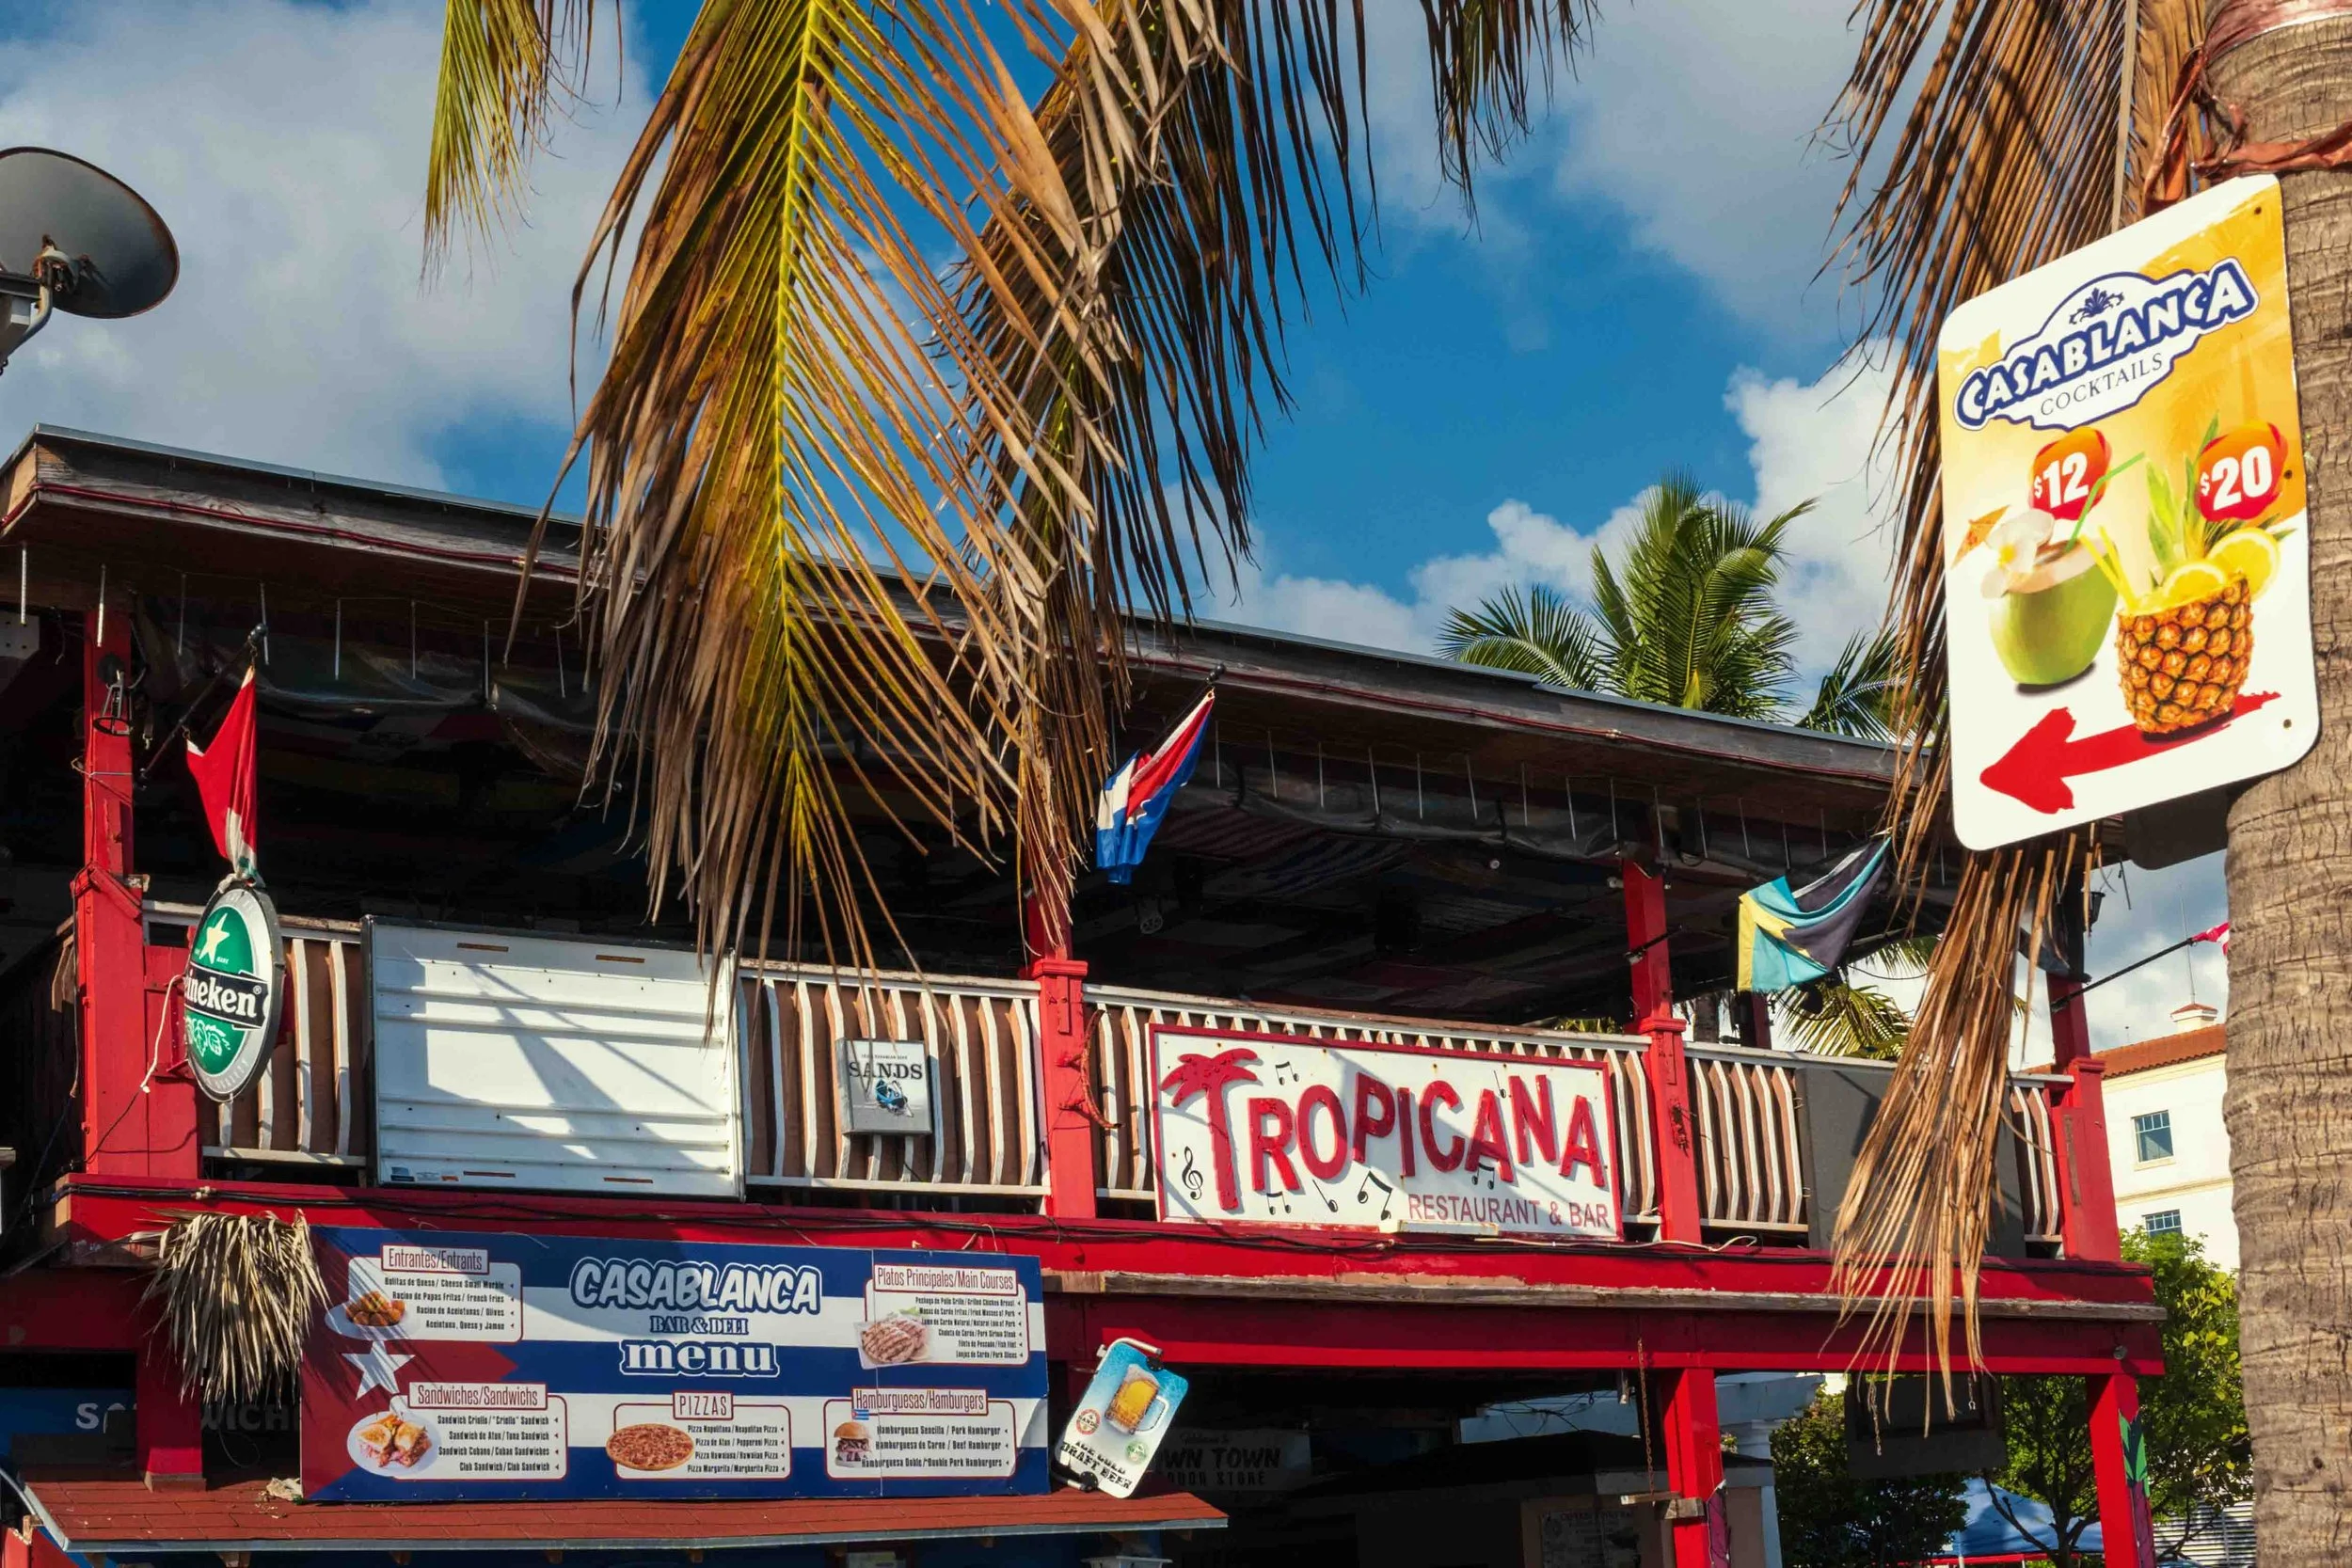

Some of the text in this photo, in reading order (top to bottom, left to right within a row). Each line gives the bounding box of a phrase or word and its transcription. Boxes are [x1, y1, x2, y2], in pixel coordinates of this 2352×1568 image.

[1959, 263, 2253, 423] CASABLANCA
[2041, 353, 2162, 416] COCKTAILS
[2033, 451, 2089, 509] $12
[2200, 446, 2272, 511] $20
[849, 1061, 922, 1080] SANDS
[1409, 1194, 1610, 1227] RESTAURANT & BAR
[573, 1261, 819, 1313] CASABLANCA
[878, 1267, 903, 1286] Platos
[980, 1271, 1013, 1290] Courses
[650, 1316, 749, 1335] BAR & DELI
[624, 1342, 775, 1373] menu
[679, 1395, 728, 1416] PIZZAS
[1212, 1447, 1280, 1468] TOWN
